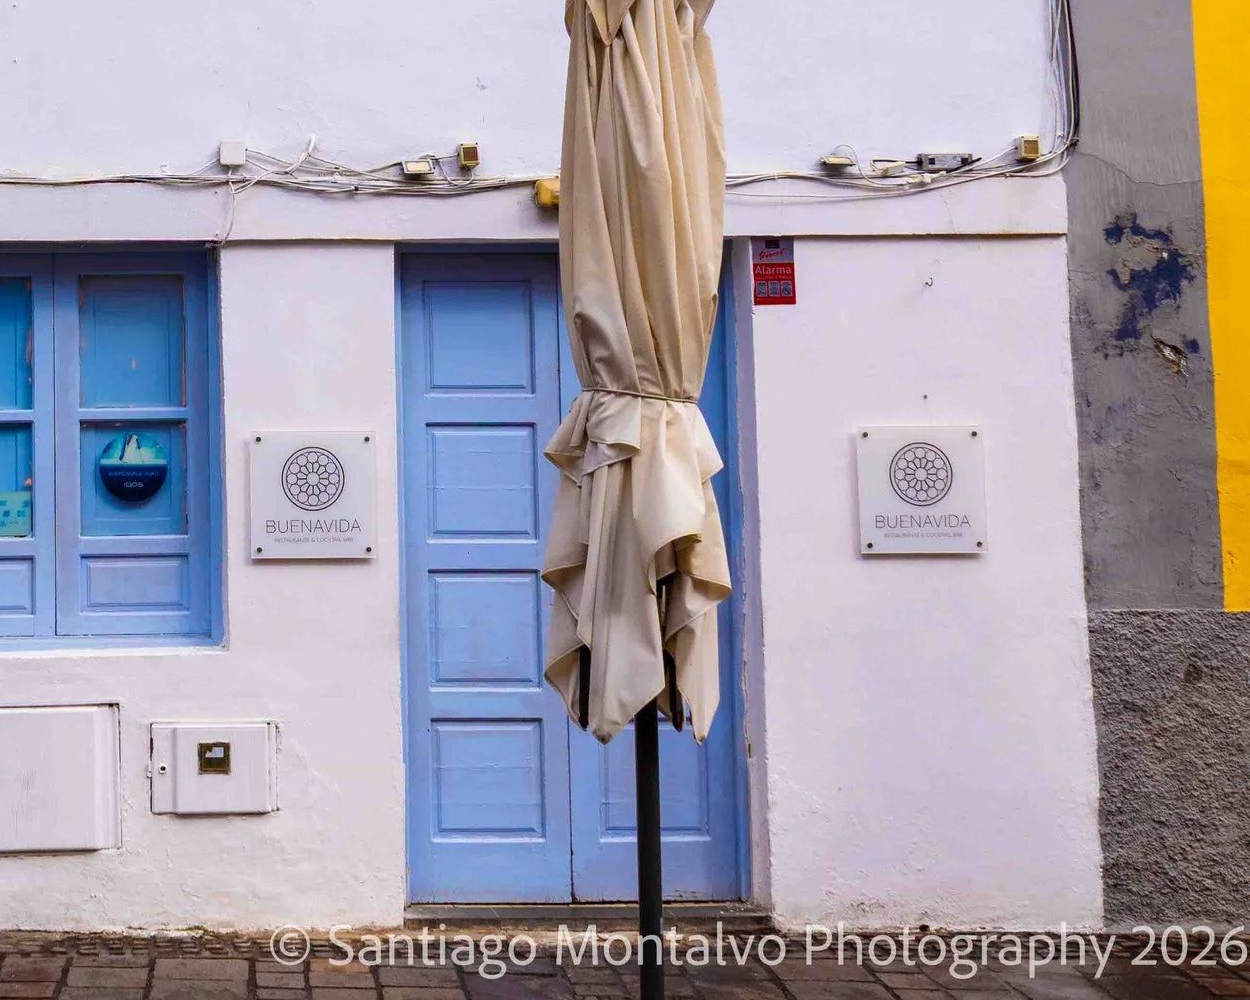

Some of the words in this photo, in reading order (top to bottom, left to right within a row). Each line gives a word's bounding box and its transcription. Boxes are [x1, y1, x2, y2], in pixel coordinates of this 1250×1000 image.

[755, 265, 792, 274] Alarma
[265, 519, 362, 533] BUENAVIDA
[875, 514, 971, 529] BUENAVIDA
